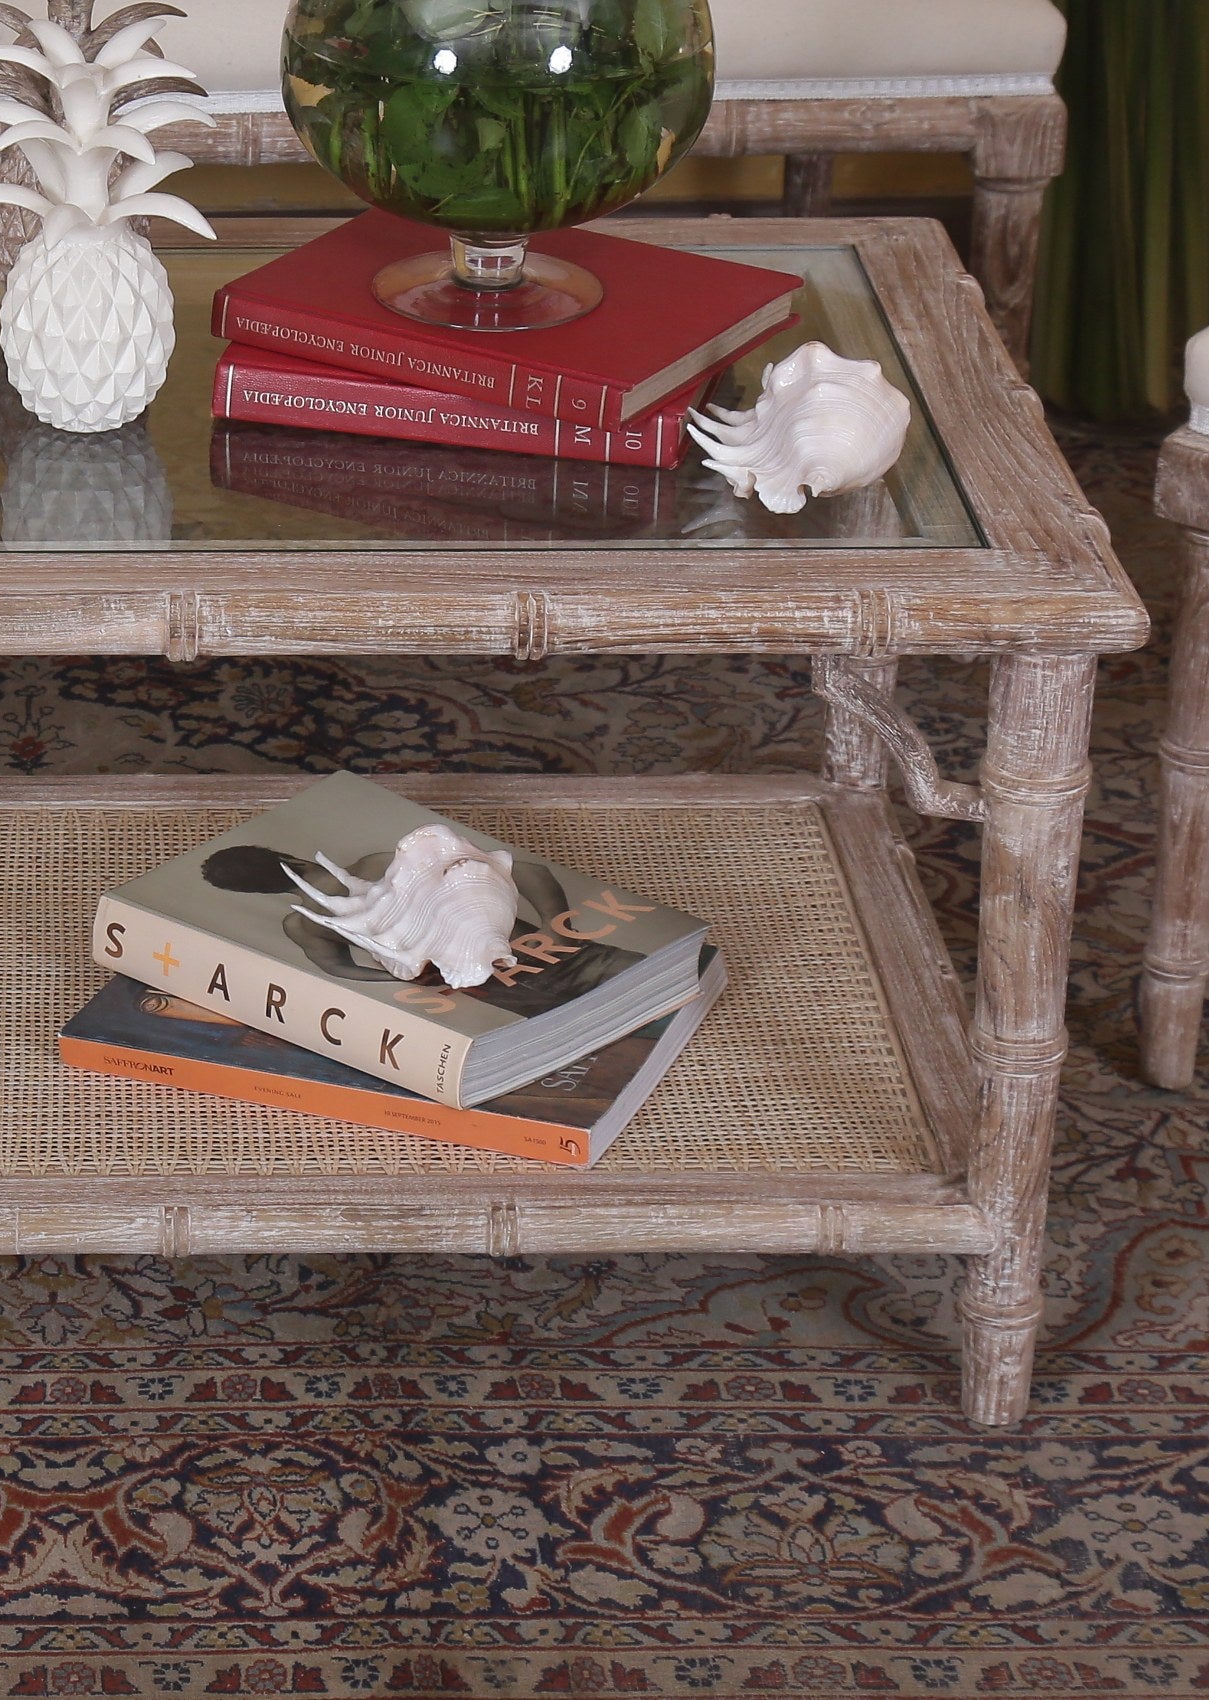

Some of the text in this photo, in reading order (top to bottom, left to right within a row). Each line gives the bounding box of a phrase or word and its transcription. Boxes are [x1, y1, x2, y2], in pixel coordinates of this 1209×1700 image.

[350, 343, 405, 367] JUNIOR
[408, 357, 496, 389] BRITANNICA
[374, 405, 437, 424] JUNIOR
[439, 412, 539, 436] BRITANNICA
[574, 424, 592, 446] M
[624, 431, 642, 451] 10
[103, 1055, 175, 1077] SAFFRONART
[437, 1043, 452, 1094] TASCHEN
[391, 1111, 426, 1122] SEPTEMBER
